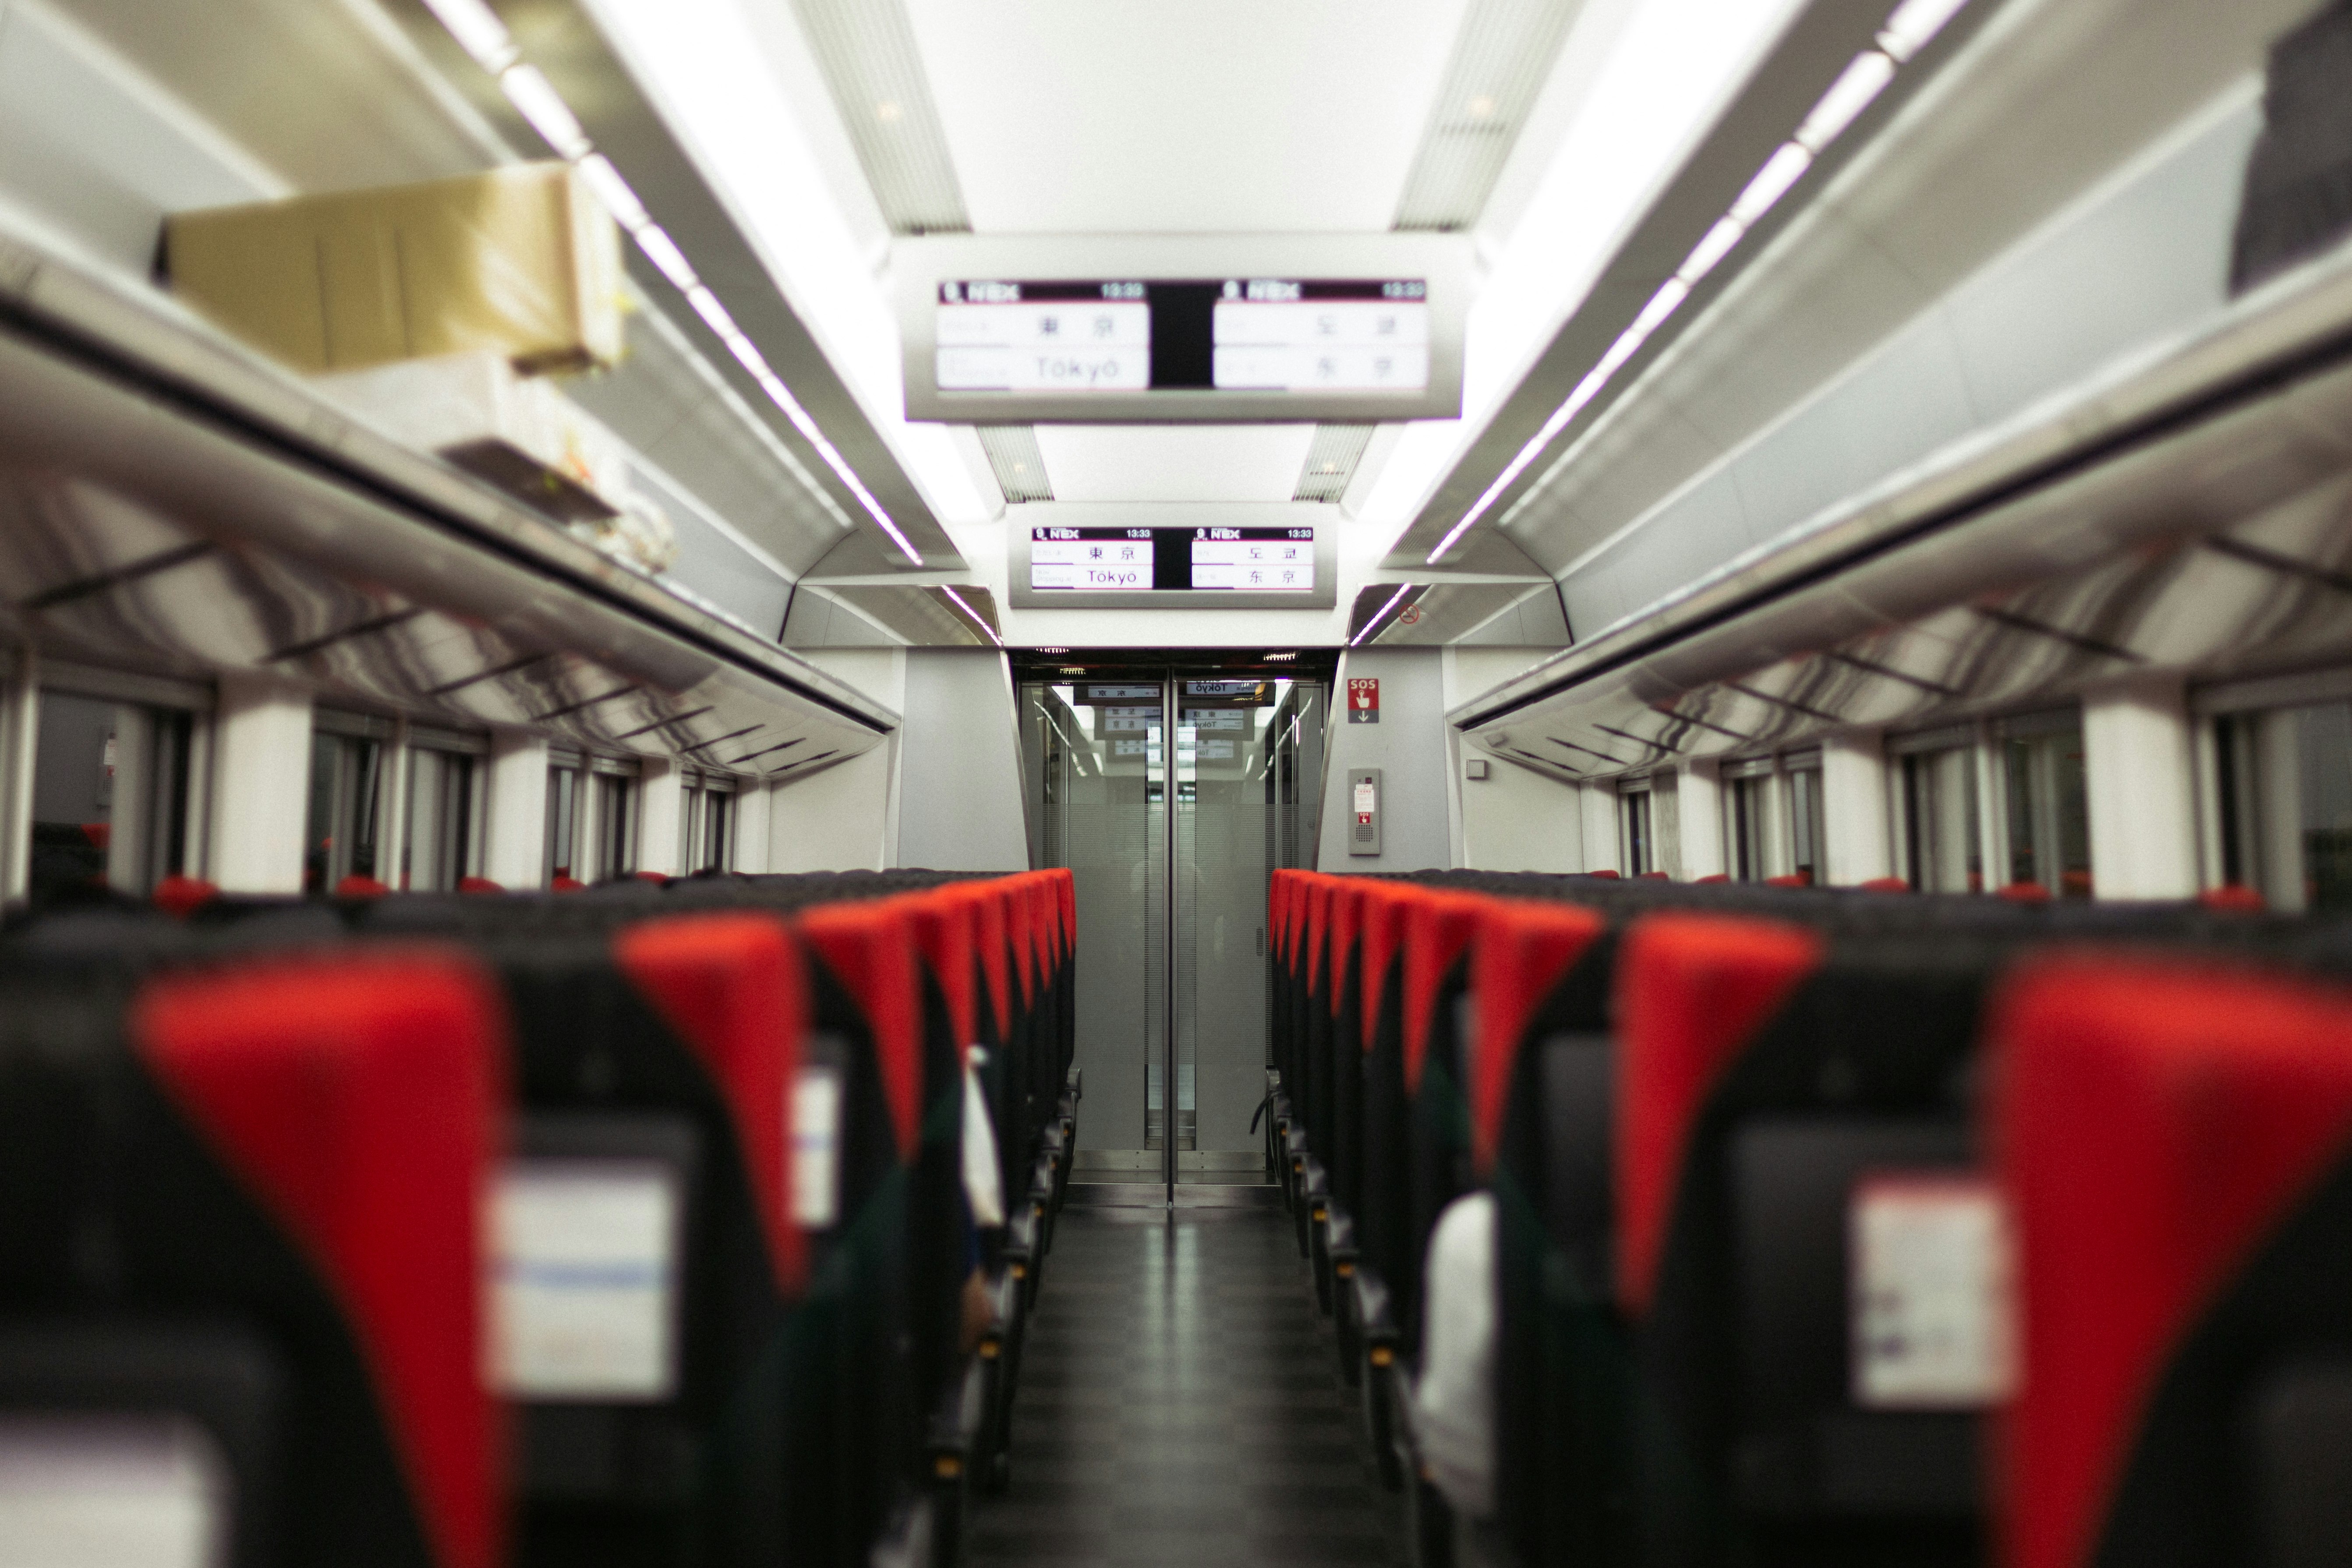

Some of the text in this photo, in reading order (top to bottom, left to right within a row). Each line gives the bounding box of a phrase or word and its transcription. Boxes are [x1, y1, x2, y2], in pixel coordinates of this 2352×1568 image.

[1036, 528, 1043, 538] 9
[1127, 529, 1150, 538] 13:33
[1197, 528, 1205, 538] 9
[1288, 529, 1312, 538] 13:33
[1089, 546, 1135, 560] 東京
[1248, 548, 1296, 559] 도쿄
[1249, 570, 1295, 583] 东京
[1351, 680, 1376, 689] SOS
